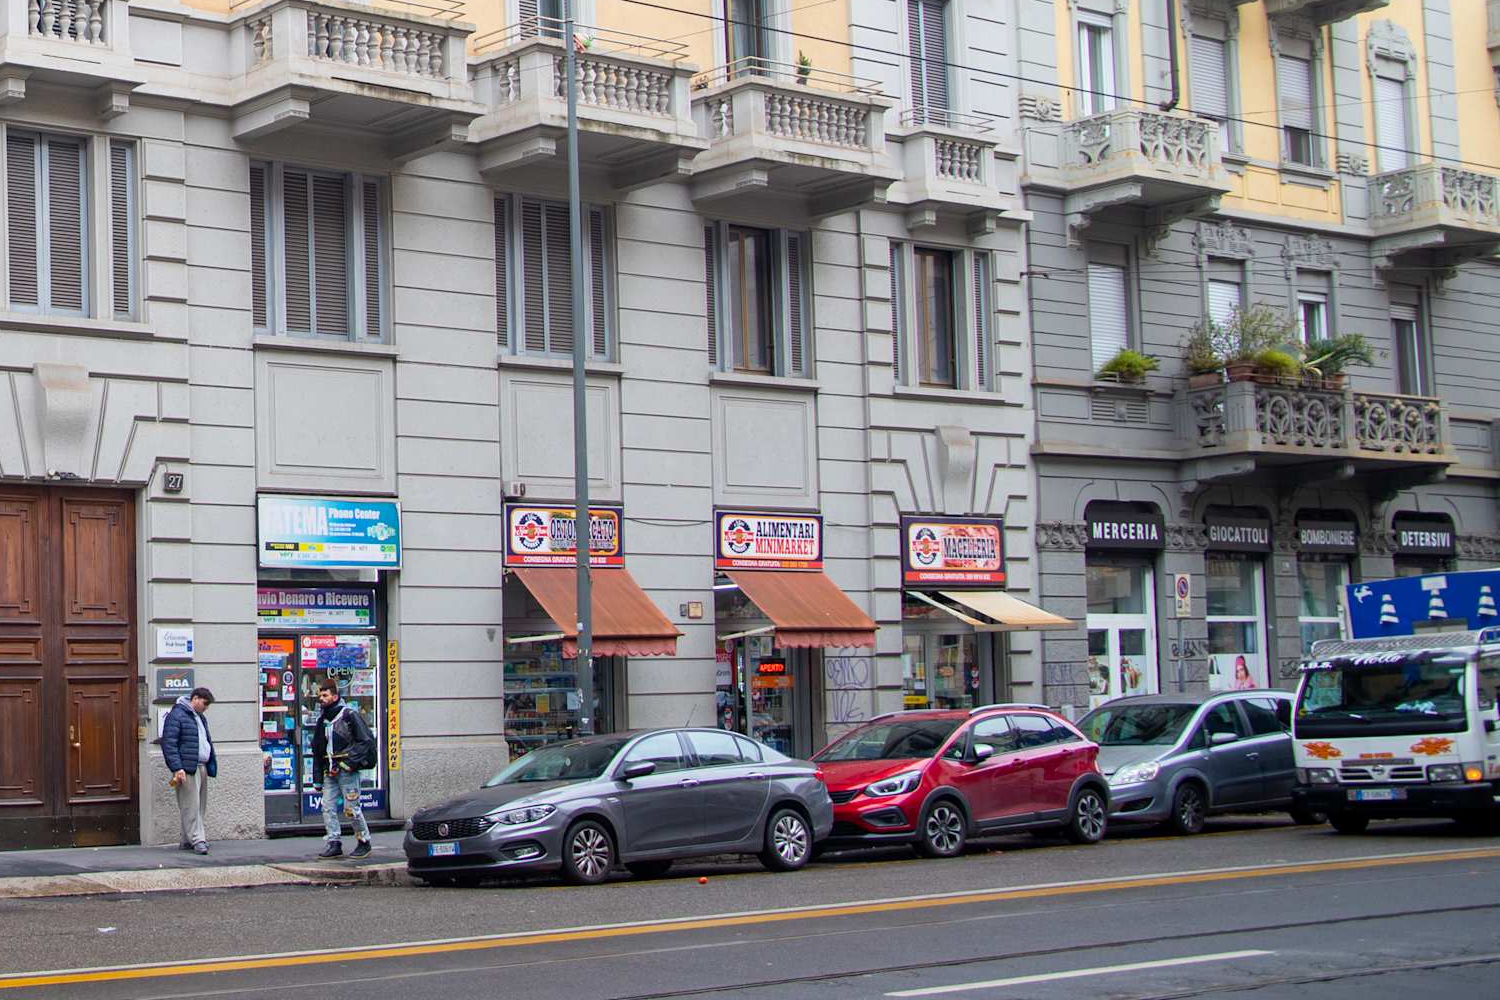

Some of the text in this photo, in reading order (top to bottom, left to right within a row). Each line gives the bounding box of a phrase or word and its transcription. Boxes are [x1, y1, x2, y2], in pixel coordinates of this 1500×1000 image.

[168, 475, 182, 489] 27
[328, 507, 380, 521] Phone Center
[550, 518, 615, 540] ORTOCATO
[756, 521, 815, 539] ALIMENTARI
[1092, 521, 1159, 540] MERCERIA
[1209, 525, 1268, 544] GIOCATTOLI
[1300, 529, 1355, 546] BOMBONIERE
[755, 538, 815, 555] MINIMARKET
[1401, 530, 1451, 547] DETERSIVI
[943, 537, 996, 559] MACELLERIA
[279, 592, 316, 606] Denaro
[317, 594, 324, 606] e
[325, 592, 369, 607] Ricevere
[329, 666, 355, 676] OPEN
[389, 642, 397, 705] FOTOCOPIE
[759, 662, 785, 673] APERTO
[389, 709, 397, 730] FAX
[389, 733, 398, 768] PHONE
